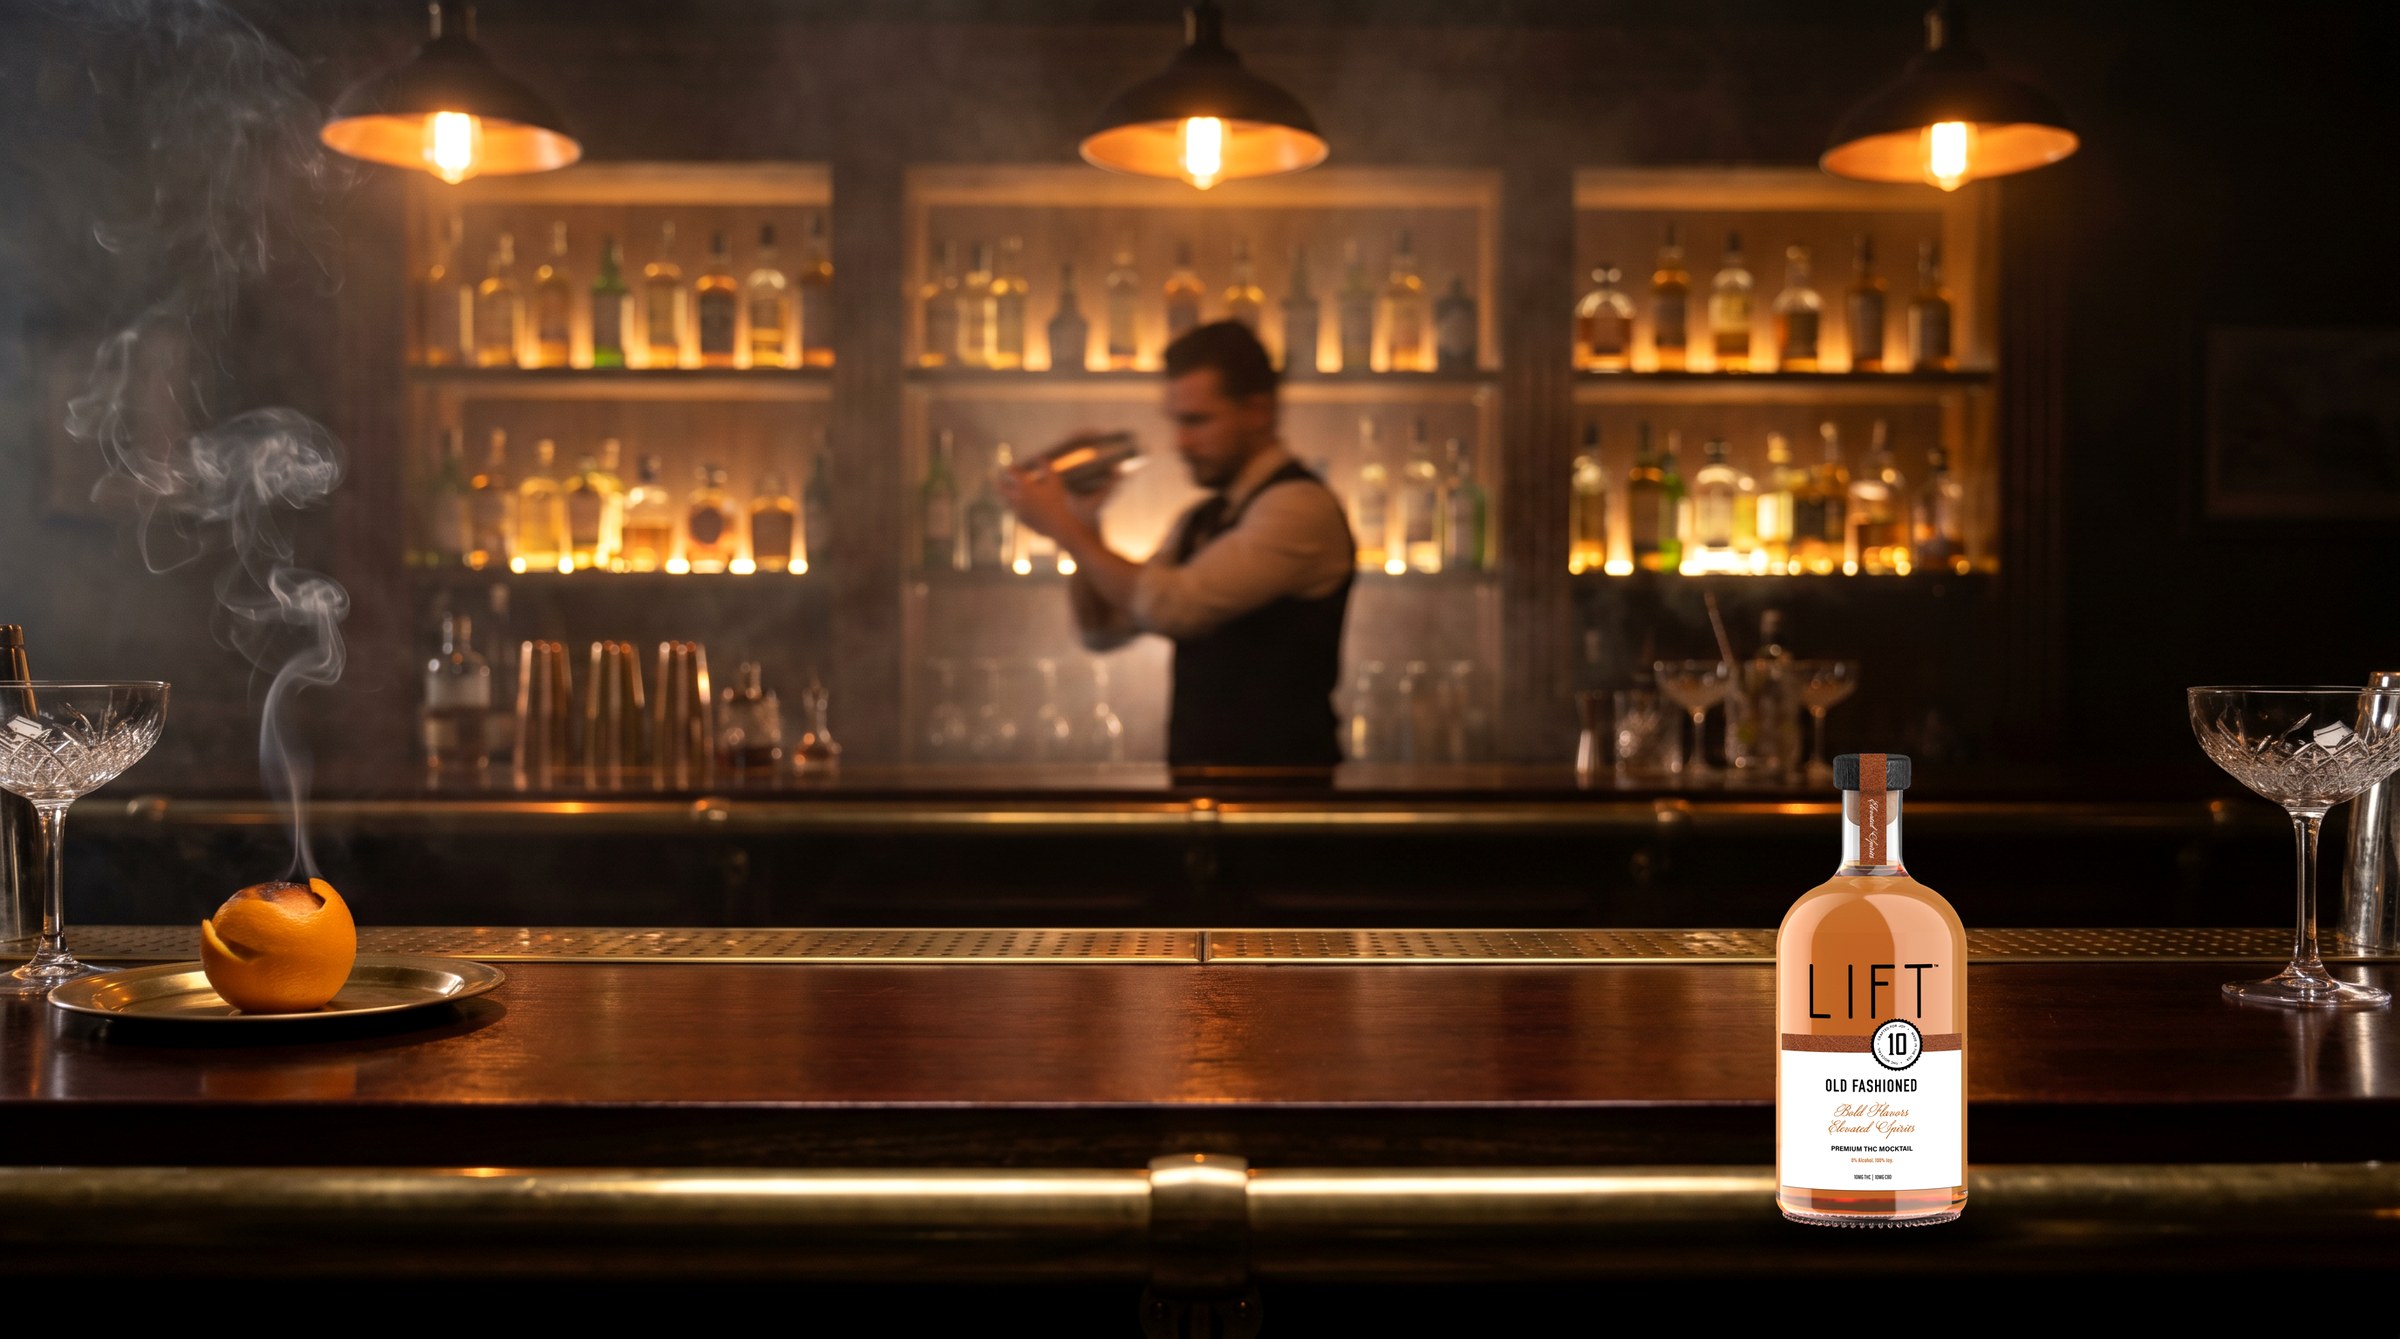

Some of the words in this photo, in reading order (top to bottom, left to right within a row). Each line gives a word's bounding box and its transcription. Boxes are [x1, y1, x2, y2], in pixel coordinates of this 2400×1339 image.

[1868, 798, 1879, 831] Elevated
[1865, 830, 1879, 859] Spirits
[1888, 1033, 1907, 1055] 10
[1825, 1078, 1847, 1092] OLD
[1852, 1078, 1918, 1092] FASHIONED
[1833, 1103, 1867, 1117] Bold
[1867, 1101, 1909, 1117] Flavors
[1828, 1120, 1874, 1135] Elevated
[1876, 1120, 1915, 1139] Spirits
[1879, 1145, 1914, 1153] MOCKTAIL
